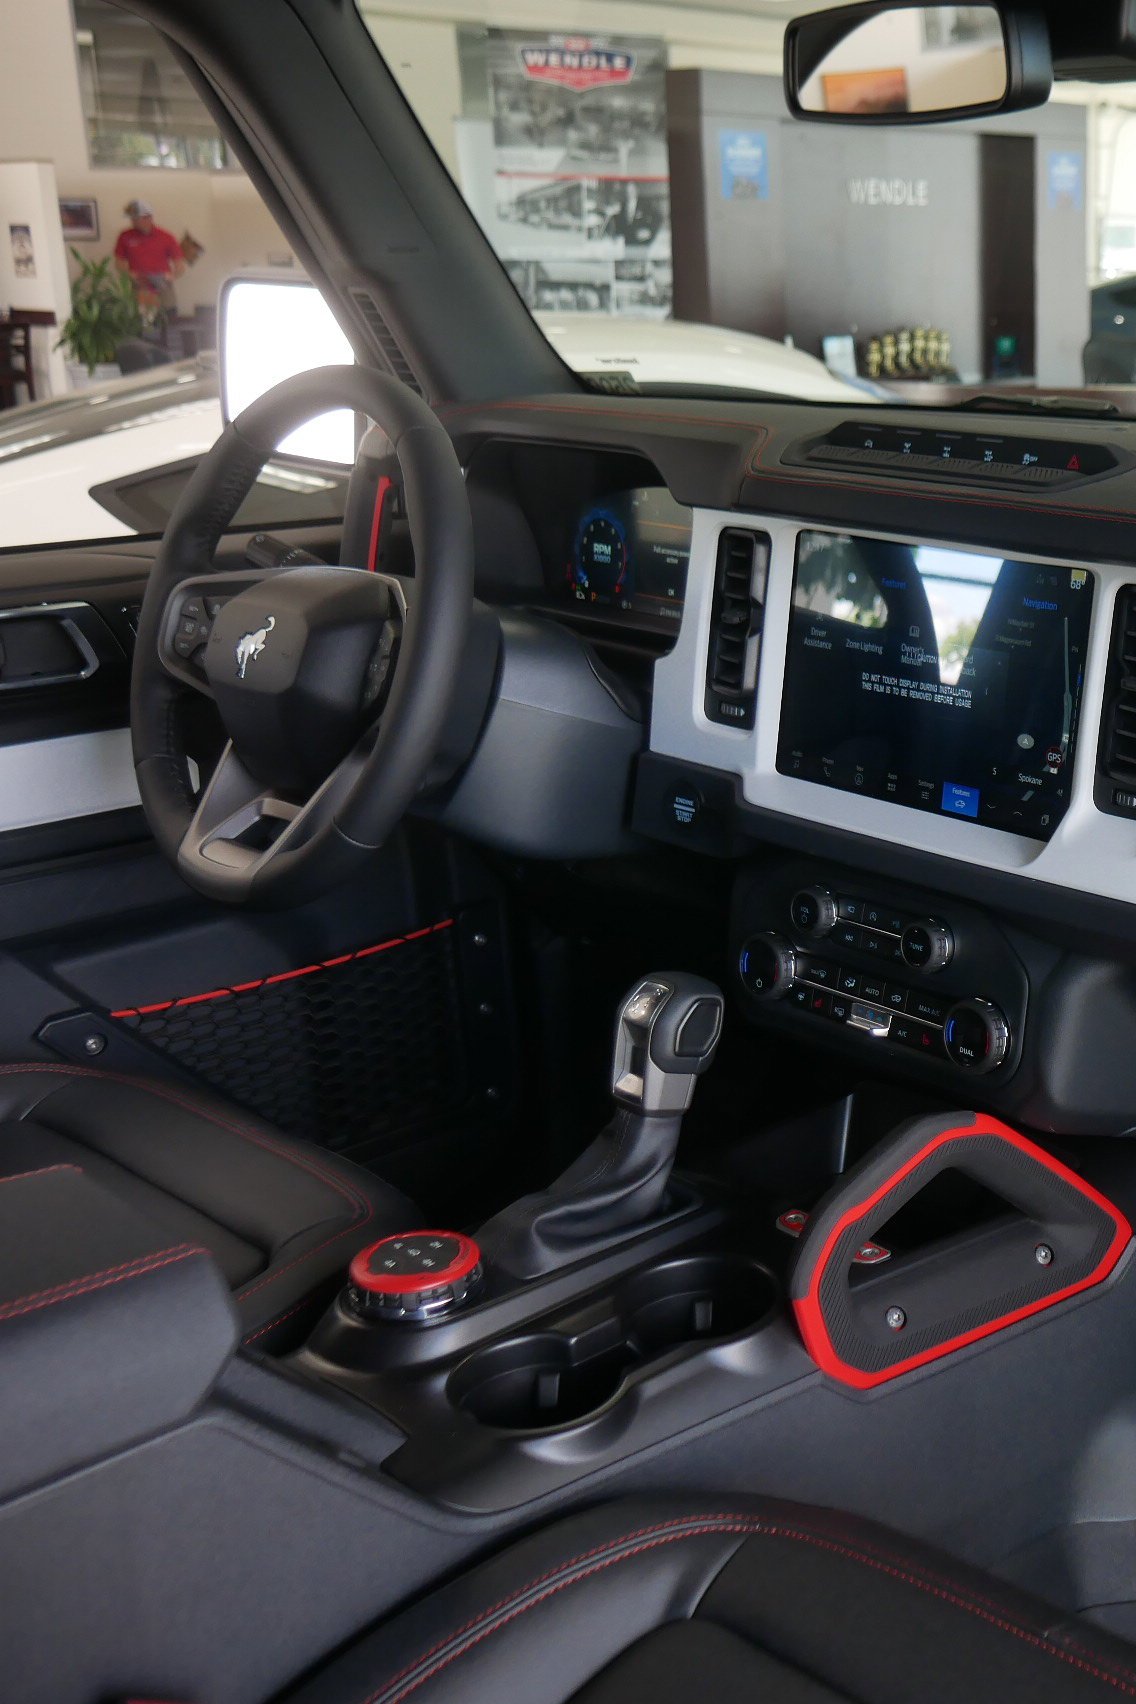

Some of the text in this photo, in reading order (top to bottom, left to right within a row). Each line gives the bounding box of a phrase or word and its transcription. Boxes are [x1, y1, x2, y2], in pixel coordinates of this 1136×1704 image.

[524, 50, 627, 69] WENDLE
[850, 177, 930, 206] WENDLE
[593, 543, 611, 555] RPM
[1023, 597, 1057, 611] Navigation
[804, 637, 832, 650] Assistance
[845, 639, 883, 655] Zone Lighting
[862, 672, 869, 680] DO
[882, 675, 897, 685] TOUCH
[899, 678, 918, 689] DISPLAY
[919, 682, 938, 693] DURING
[939, 685, 972, 698] INSTALLATION
[862, 681, 972, 709] THIS FILM IS TO BE REMOVED BEFORE USAGE
[1047, 752, 1061, 763] GPS
[1018, 773, 1042, 786] Spokane
[865, 986, 880, 996] AUTO
[897, 1029, 907, 1038] A/C
[959, 1046, 974, 1057] DUAL
